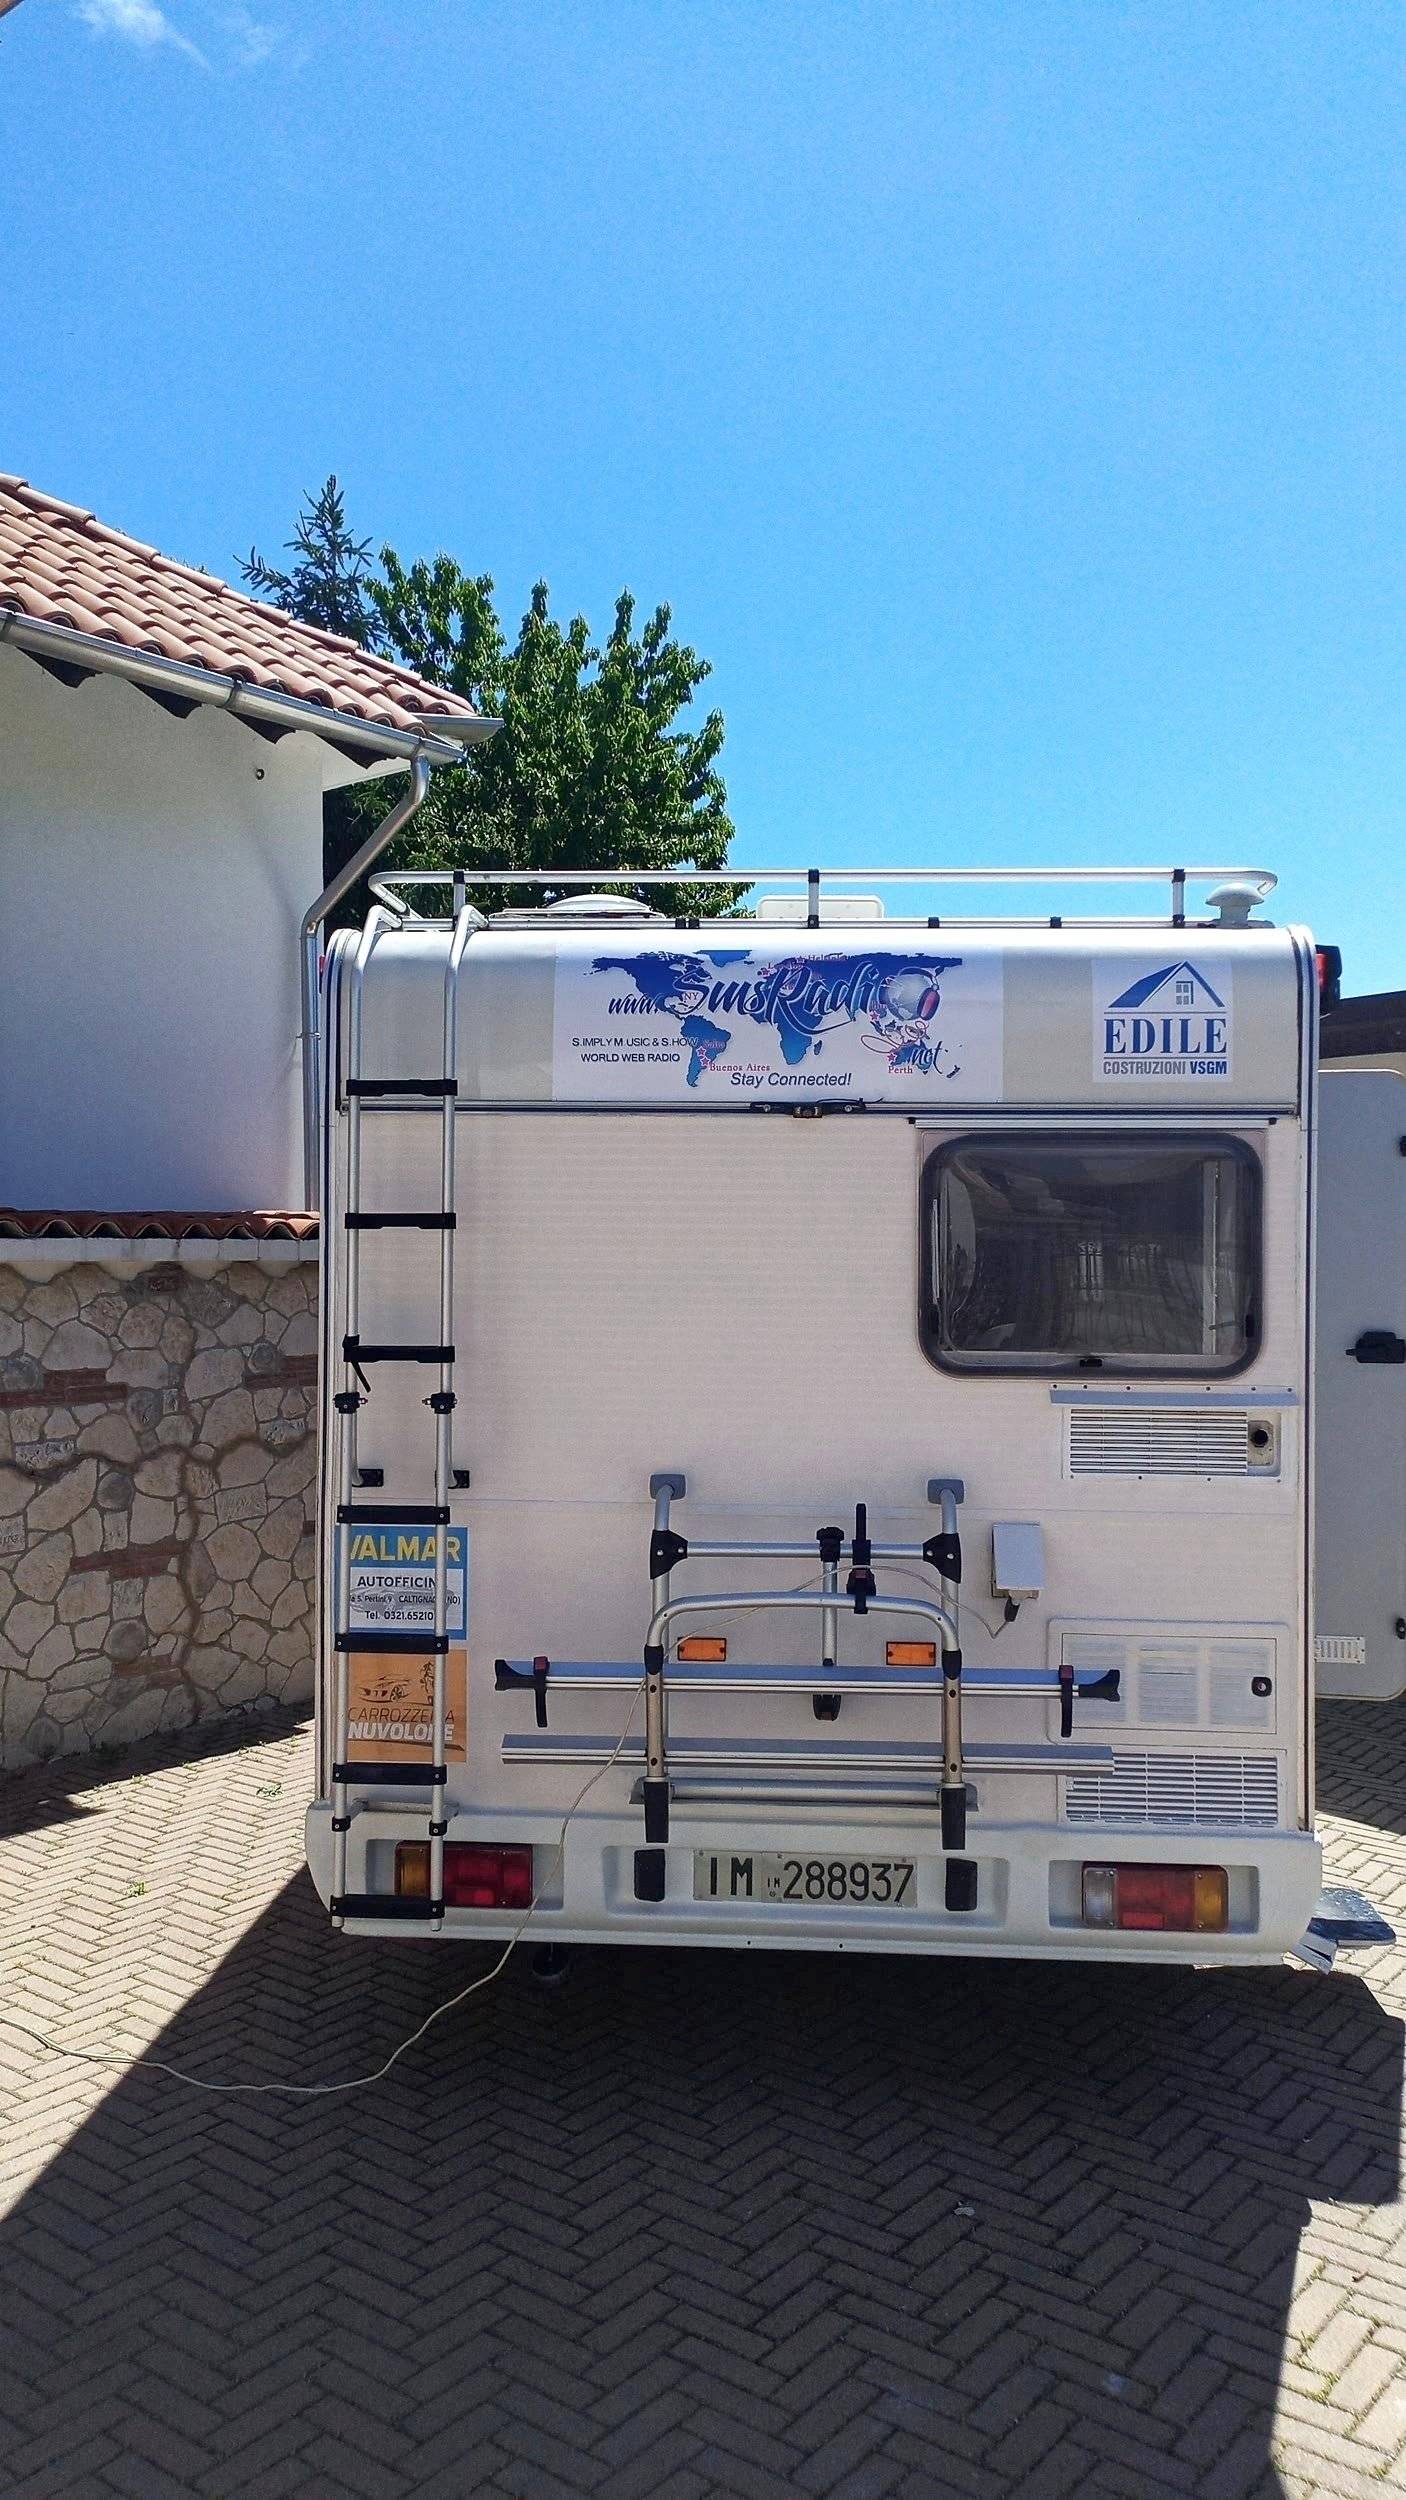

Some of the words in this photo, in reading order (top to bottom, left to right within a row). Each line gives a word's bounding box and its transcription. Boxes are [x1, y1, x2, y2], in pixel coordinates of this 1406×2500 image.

[652, 1037, 660, 1047] &
[1103, 1018, 1228, 1054] EDILE
[580, 1053, 620, 1063] WORLD
[621, 1053, 645, 1063] WEB
[647, 1053, 681, 1063] RADIO
[709, 1063, 742, 1072] Buenos
[746, 1062, 770, 1072] Aires
[888, 1065, 913, 1074] Perth
[1103, 1061, 1186, 1075] COSTRUZIONI
[1190, 1061, 1228, 1075] VSGM
[730, 1073, 764, 1088] Stay
[767, 1073, 852, 1086] Connected!
[783, 1859, 914, 1903] 288937
